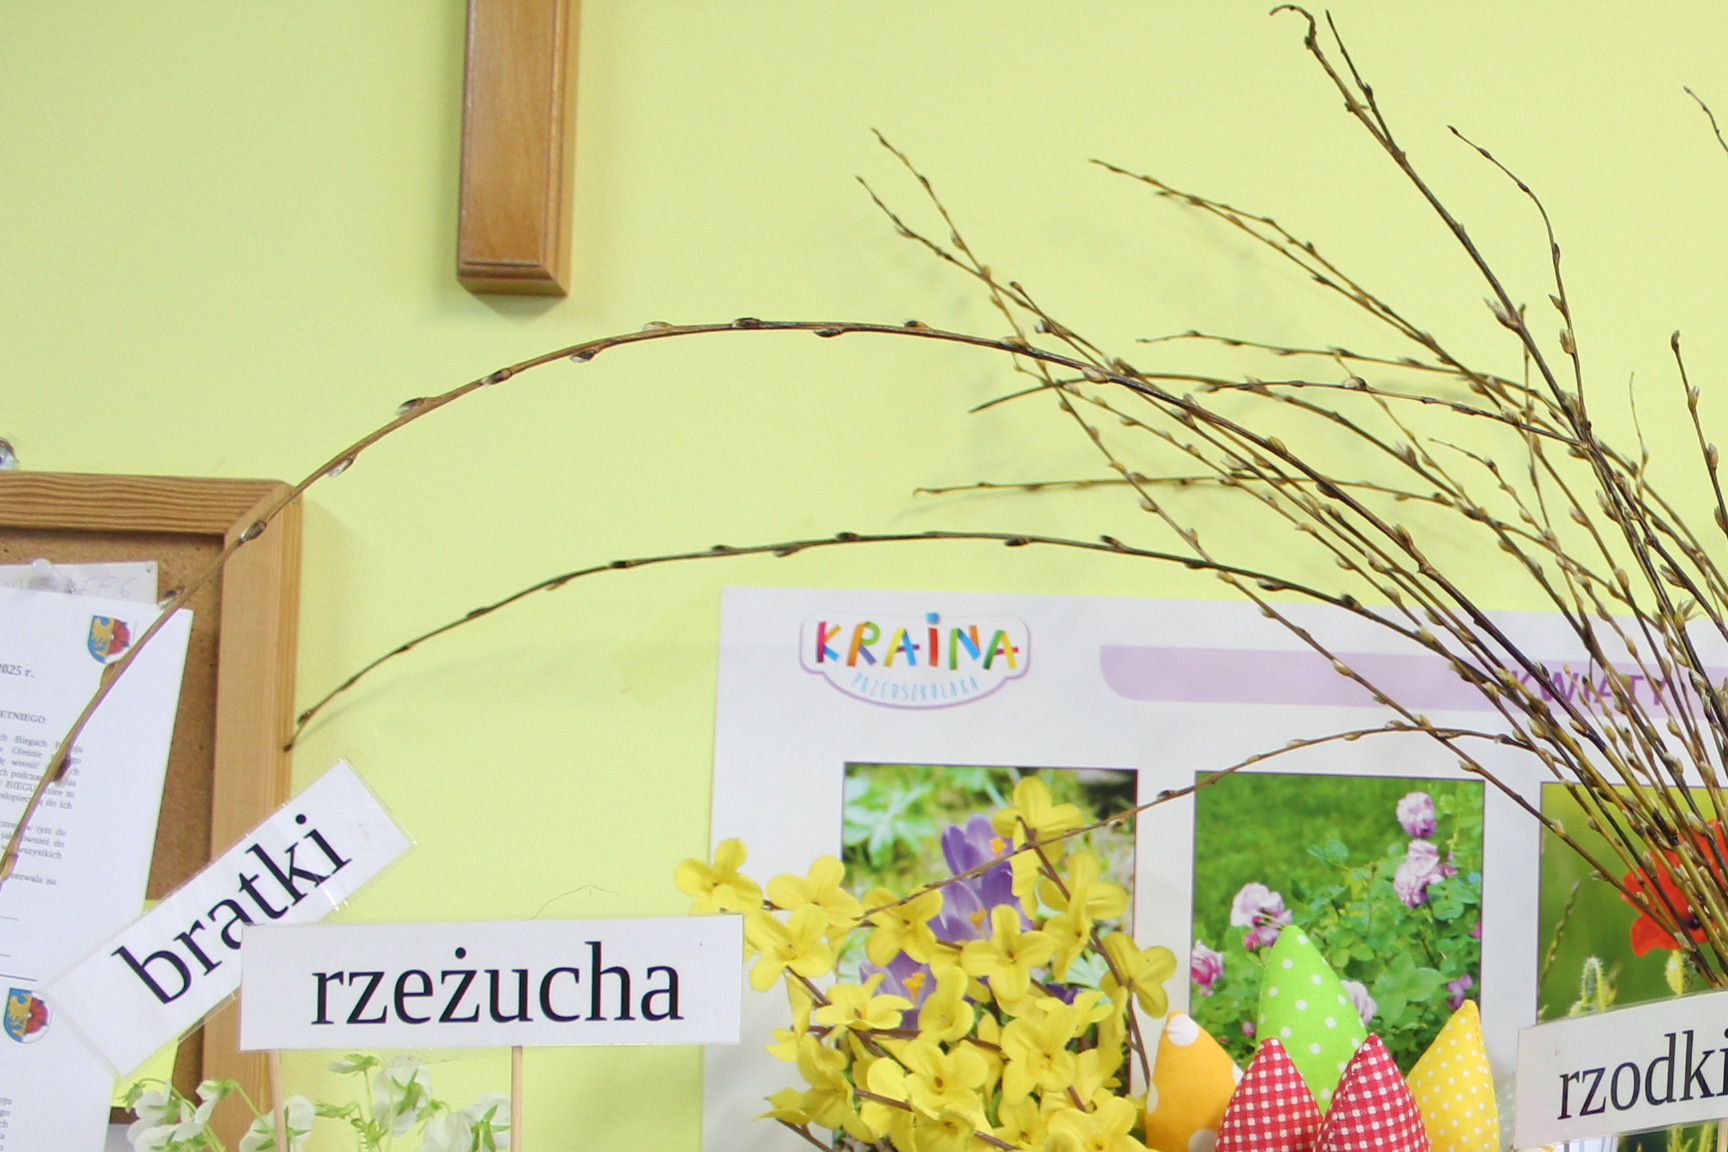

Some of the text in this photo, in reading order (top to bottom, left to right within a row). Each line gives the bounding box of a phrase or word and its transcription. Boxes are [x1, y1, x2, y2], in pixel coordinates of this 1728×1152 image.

[851, 672, 979, 701] PRZEDSZKOLAKA
[111, 814, 351, 1004] bratki
[311, 941, 684, 1025] rzeżucha
